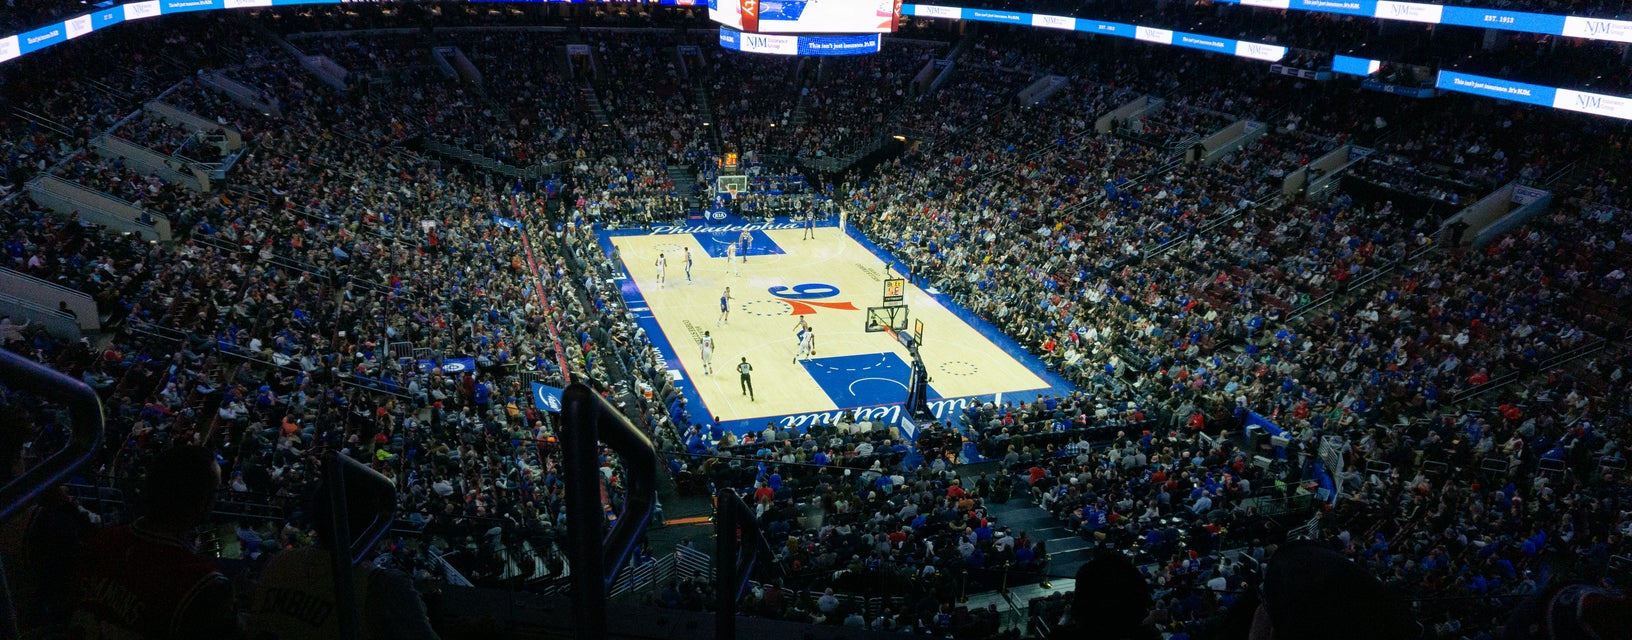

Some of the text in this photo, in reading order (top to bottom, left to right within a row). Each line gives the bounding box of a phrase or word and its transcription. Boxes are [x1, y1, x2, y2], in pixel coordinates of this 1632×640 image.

[1584, 21, 1611, 35] NJM
[746, 36, 767, 49] NJM
[1576, 94, 1601, 110] NJM
[651, 223, 800, 235] Philadelphia
